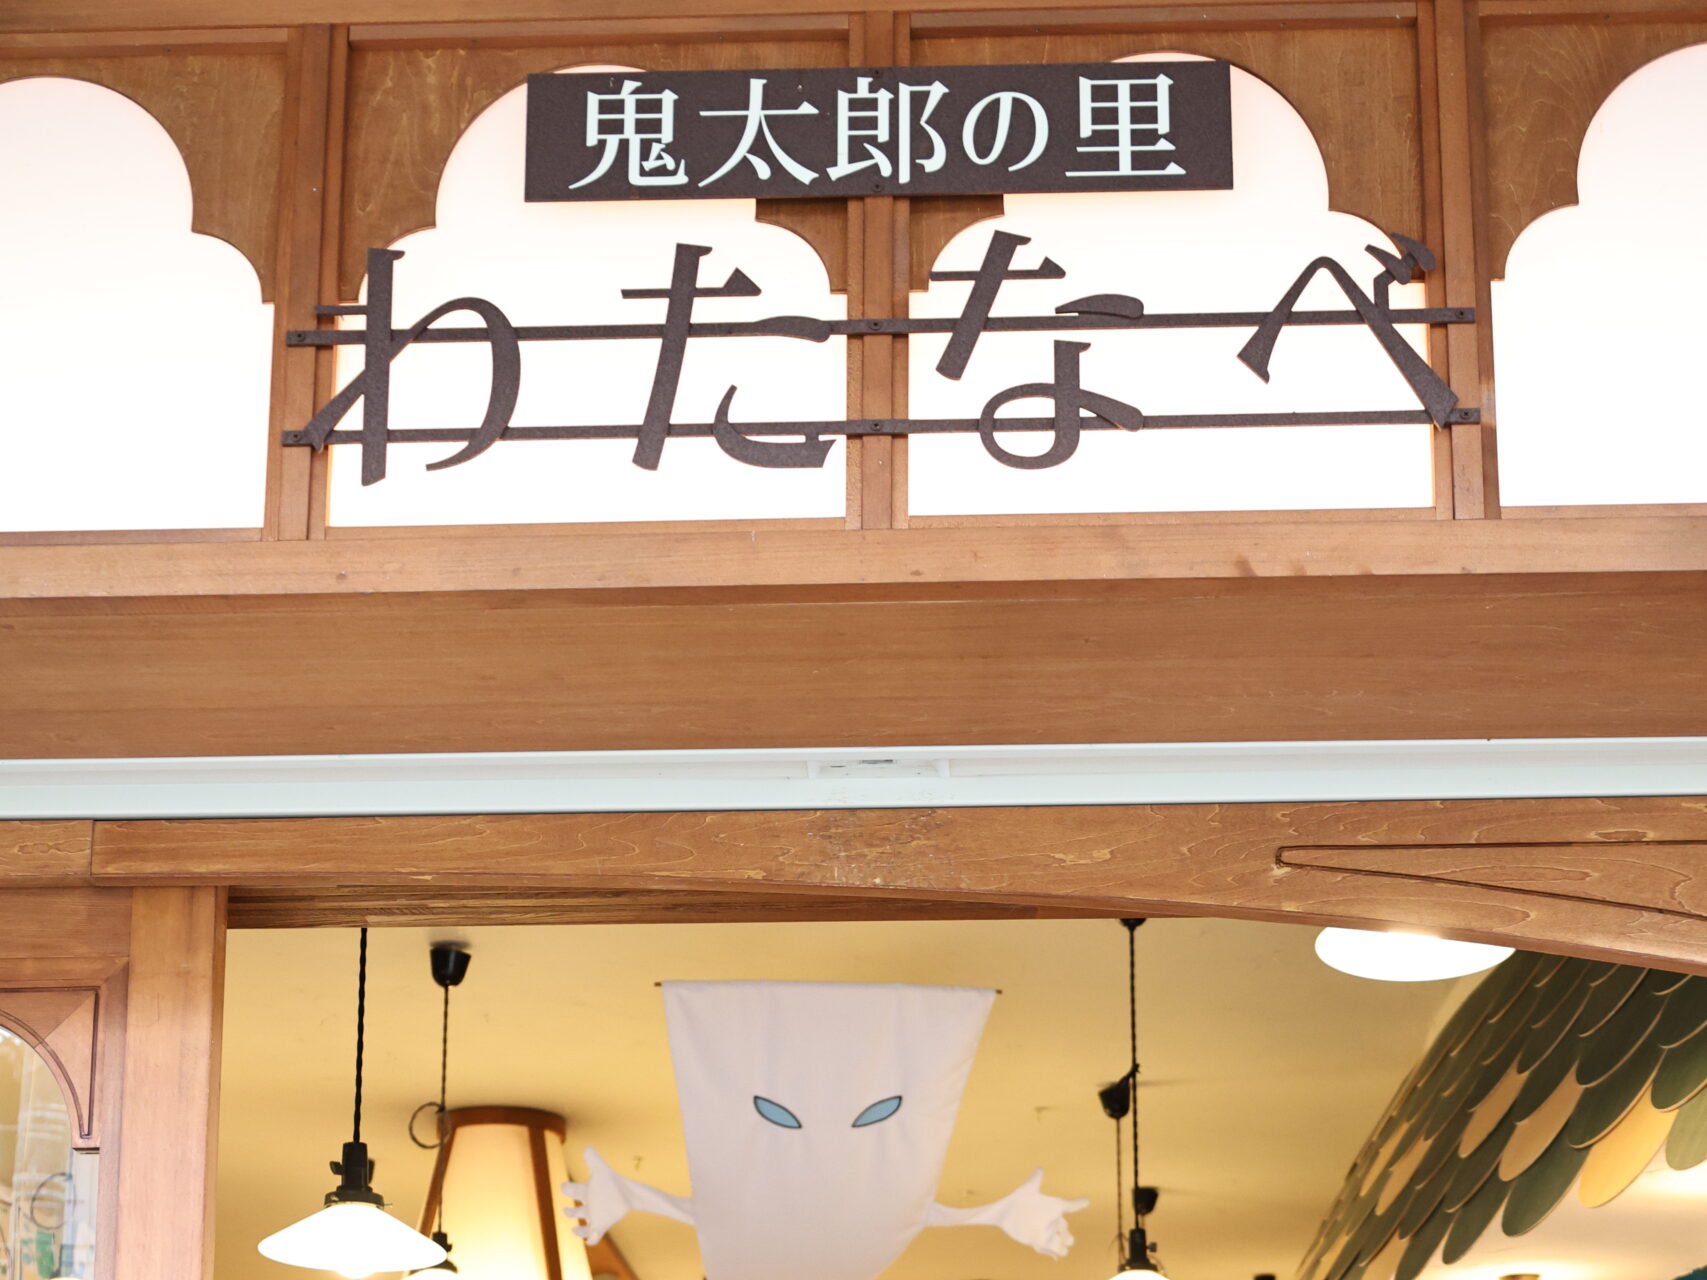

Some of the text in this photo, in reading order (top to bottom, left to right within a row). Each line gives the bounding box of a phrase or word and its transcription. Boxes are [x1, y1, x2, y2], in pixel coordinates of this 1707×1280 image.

[569, 72, 1187, 190] 鬼太郎の里
[302, 230, 1459, 487] わたなべ
